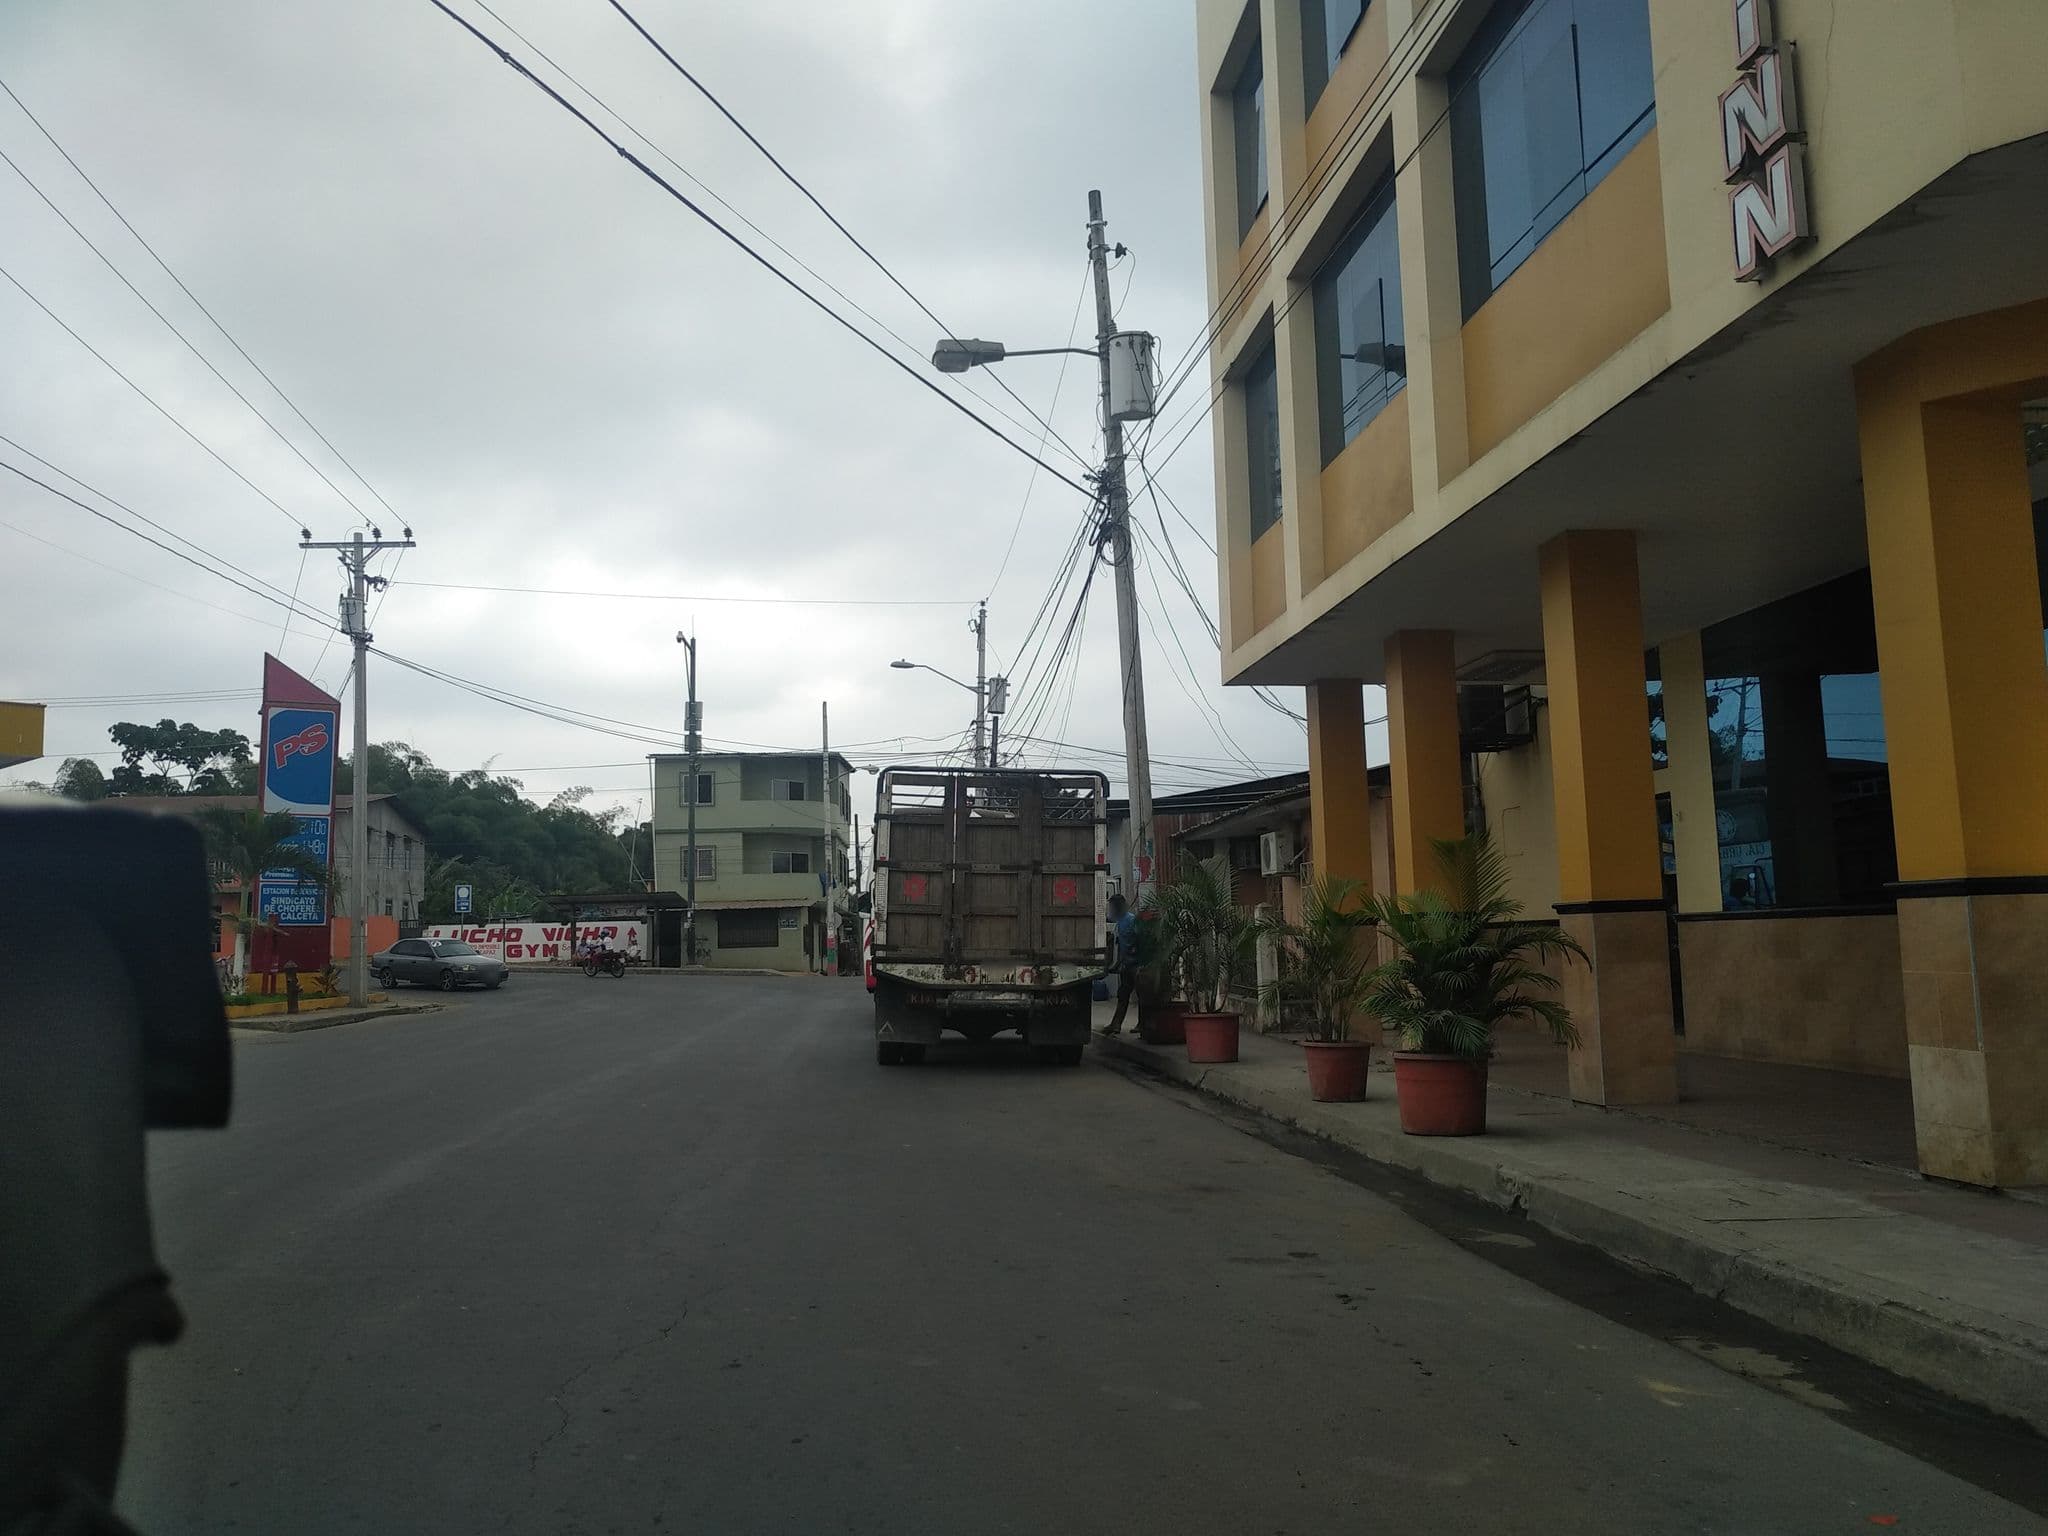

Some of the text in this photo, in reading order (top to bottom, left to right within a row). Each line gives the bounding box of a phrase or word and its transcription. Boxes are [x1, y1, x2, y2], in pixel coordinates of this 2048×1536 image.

[274, 723, 328, 769] PS
[264, 904, 276, 912] DE
[280, 912, 319, 921] CALCETA
[506, 943, 559, 958] GYM
